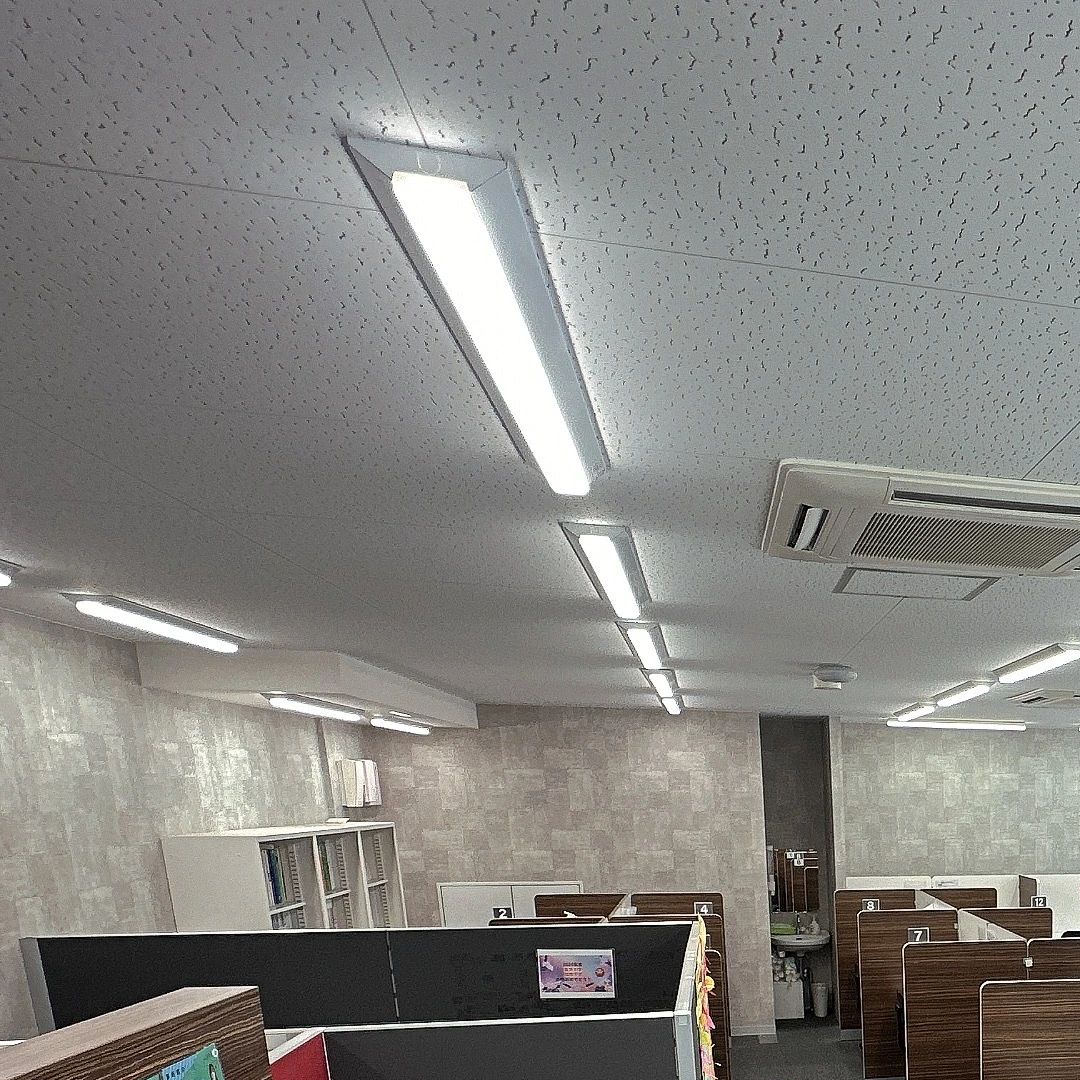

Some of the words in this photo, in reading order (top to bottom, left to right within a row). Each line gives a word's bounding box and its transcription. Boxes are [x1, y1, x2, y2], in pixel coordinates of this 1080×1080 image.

[866, 901, 875, 910] 8
[1034, 897, 1044, 907] 12
[499, 909, 508, 919] 2
[700, 905, 709, 915] 4
[913, 930, 923, 942] 7
